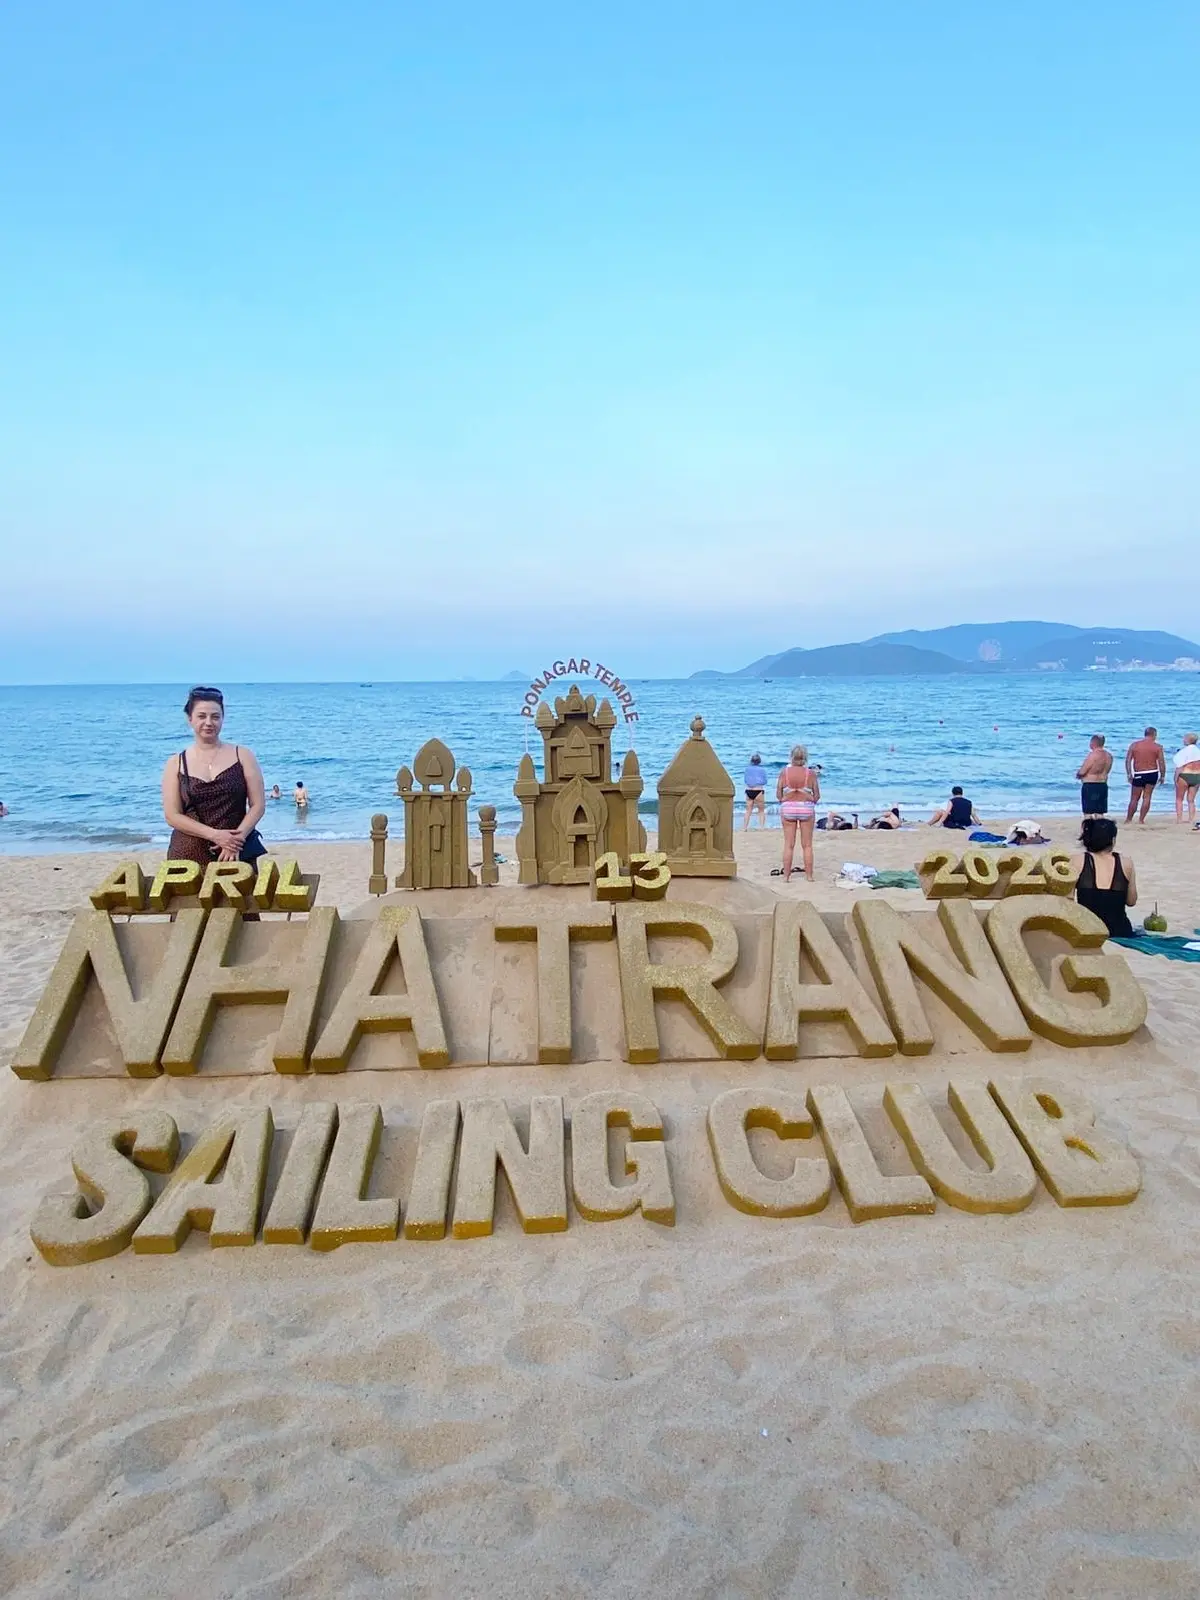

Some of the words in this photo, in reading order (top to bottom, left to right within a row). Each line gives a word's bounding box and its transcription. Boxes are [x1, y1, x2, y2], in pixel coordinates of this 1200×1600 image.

[520, 658, 591, 718] PONAGAR
[593, 663, 639, 723] TEMPLE
[90, 859, 312, 910] APRIL
[594, 850, 672, 900] 13
[920, 850, 1077, 896] 2026
[11, 904, 450, 1080] NHA
[495, 895, 1148, 1063] TRANG
[31, 1093, 675, 1266] SAILING
[707, 1080, 1143, 1224] CLUB
